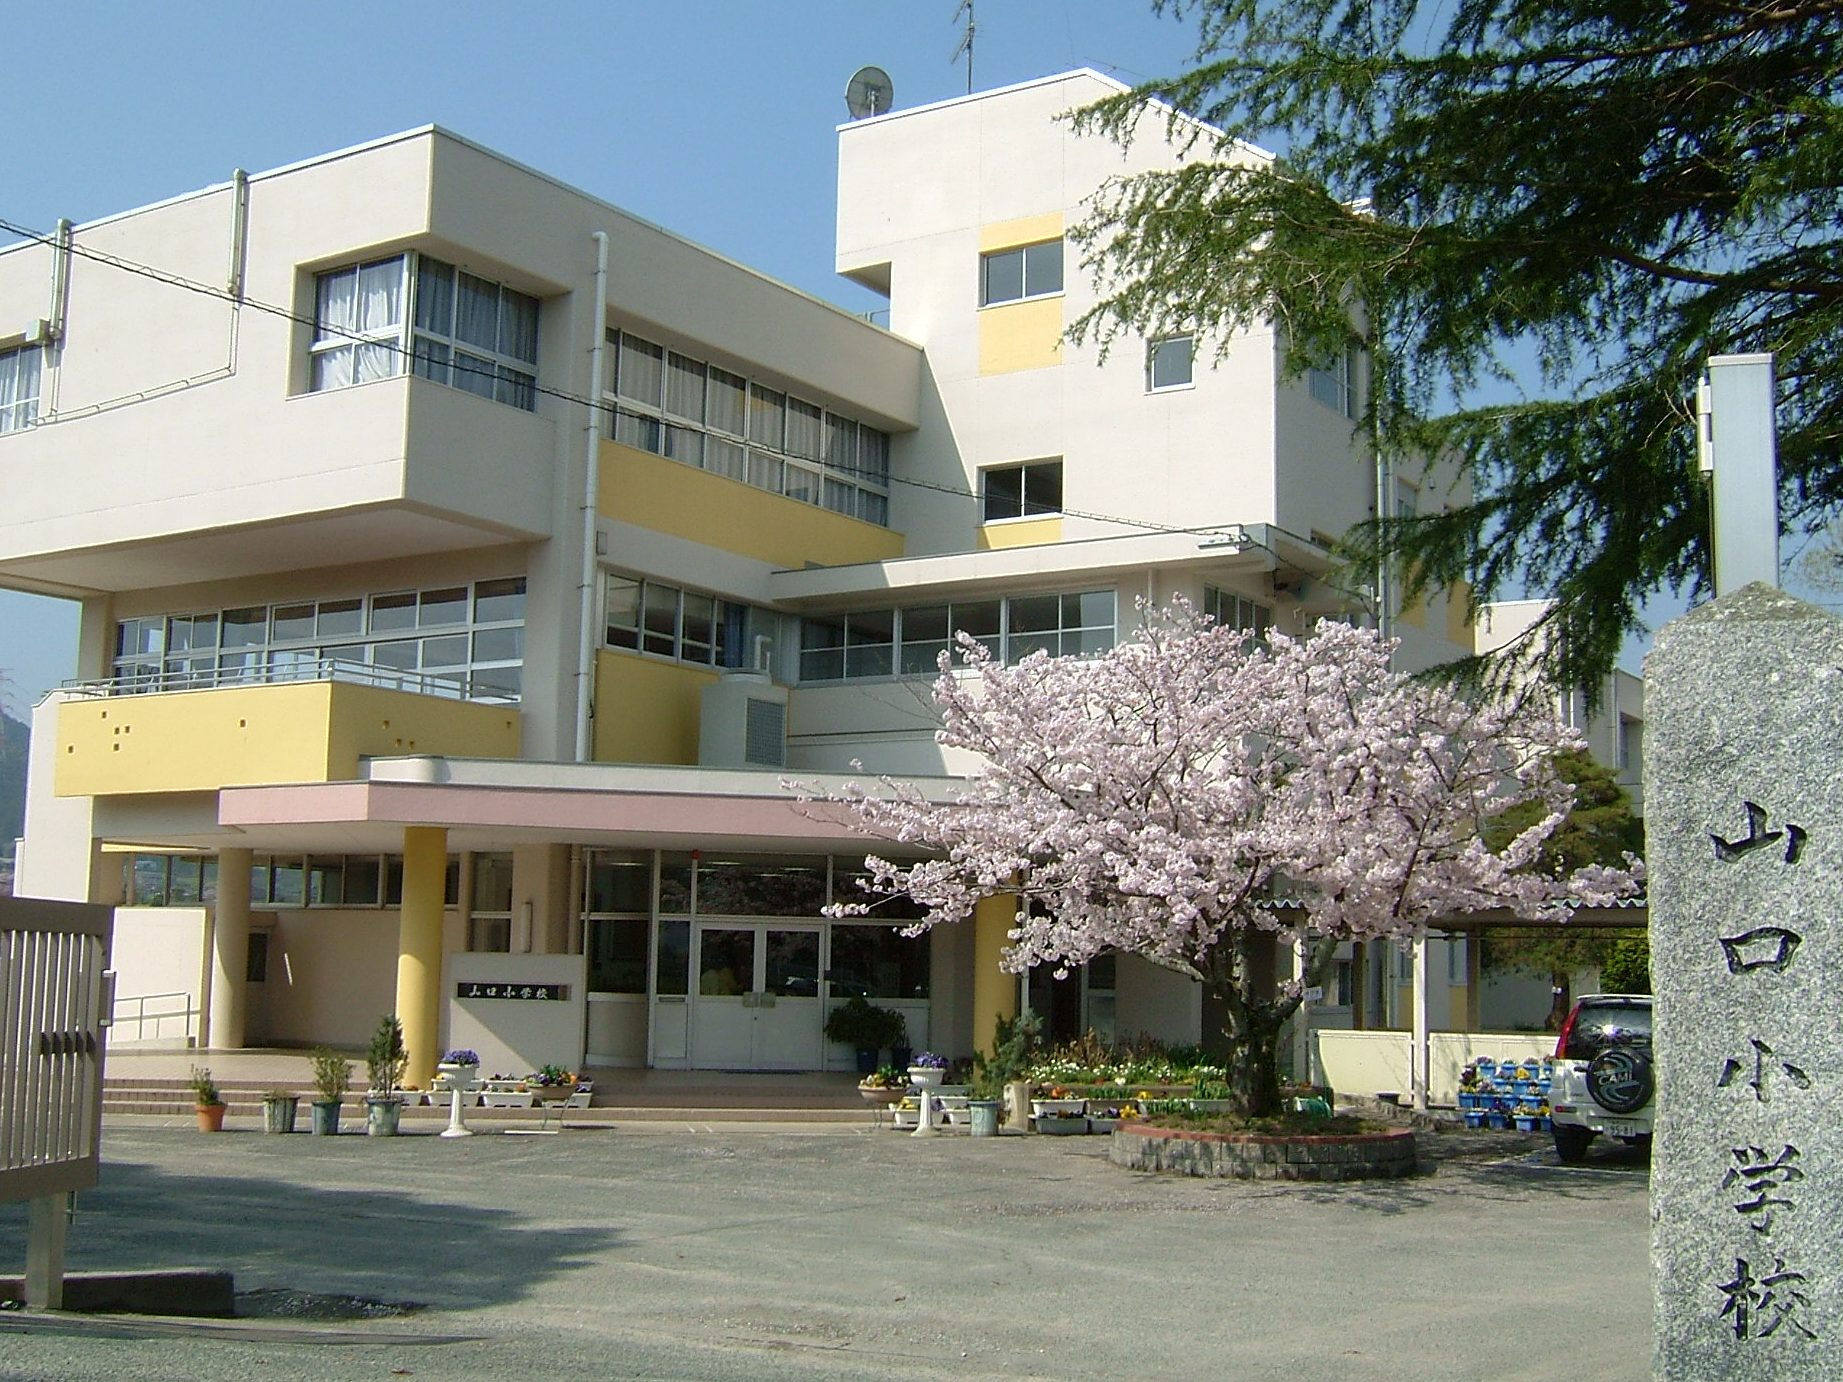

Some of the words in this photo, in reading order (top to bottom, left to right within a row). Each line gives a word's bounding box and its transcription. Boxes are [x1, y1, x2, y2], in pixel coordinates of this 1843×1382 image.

[1709, 799, 1818, 1341] 山口小学校
